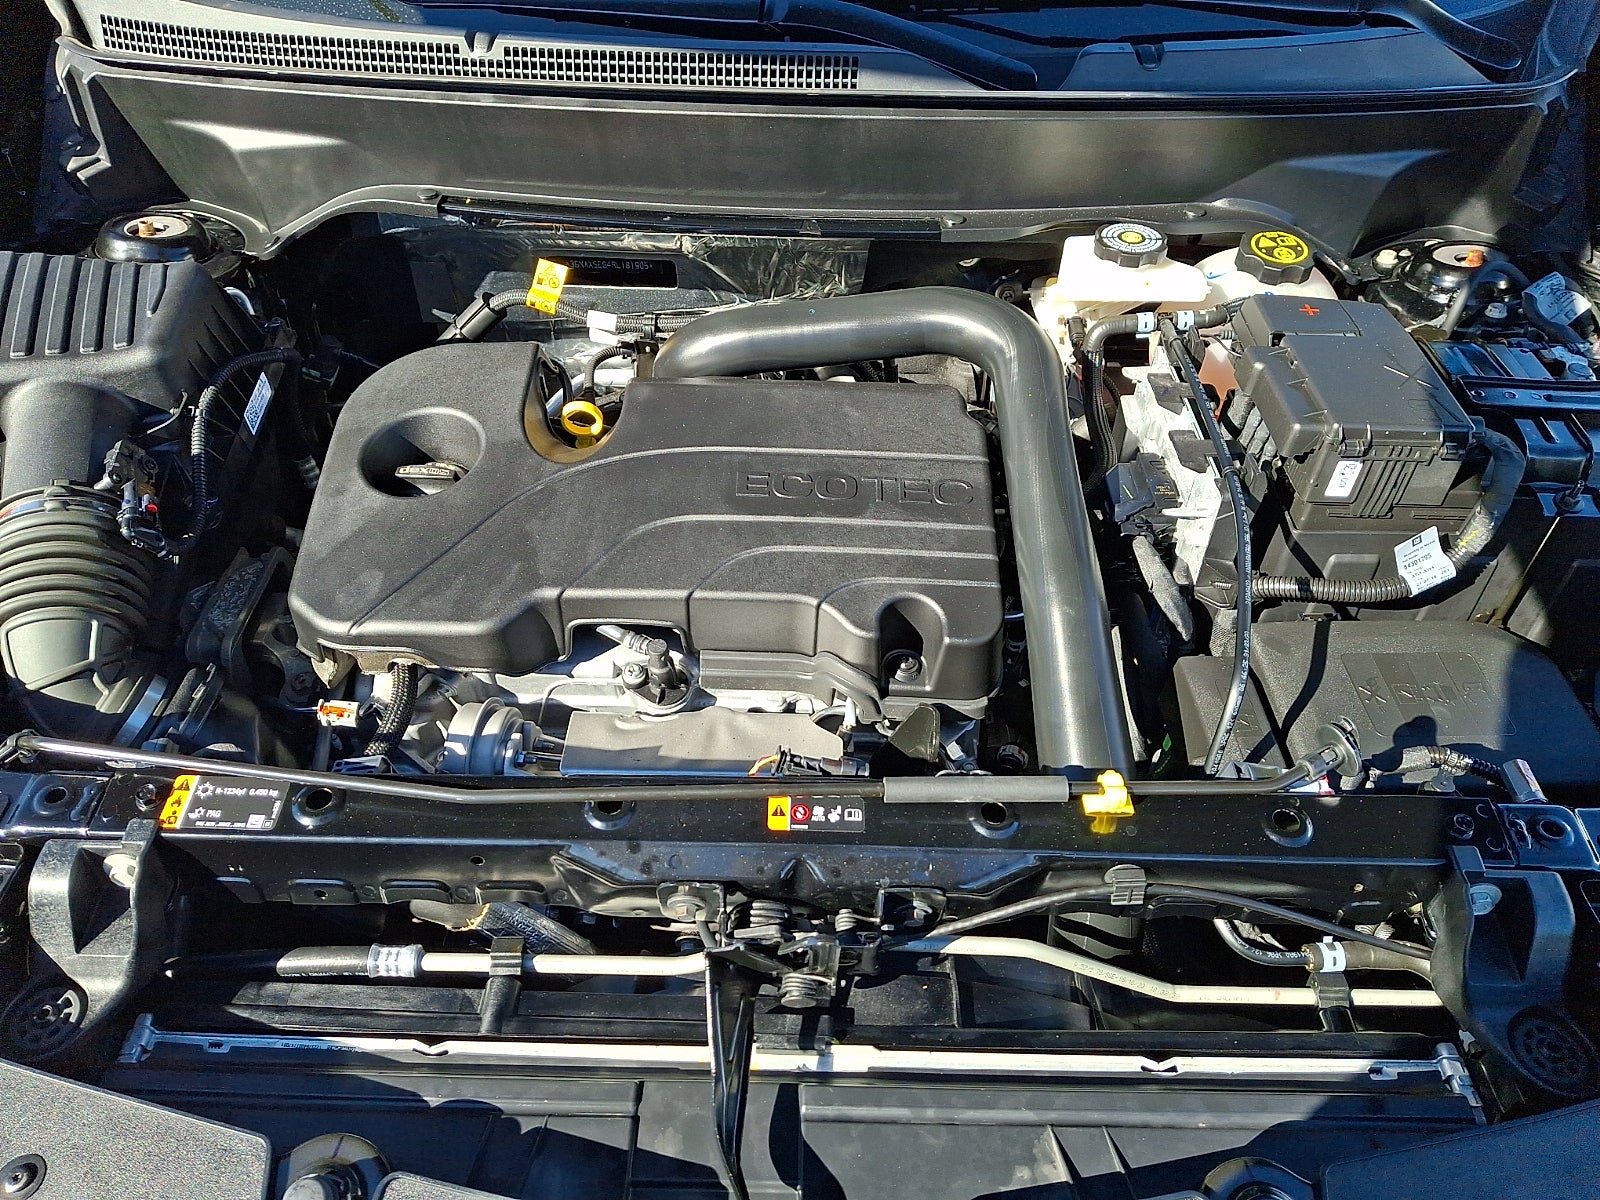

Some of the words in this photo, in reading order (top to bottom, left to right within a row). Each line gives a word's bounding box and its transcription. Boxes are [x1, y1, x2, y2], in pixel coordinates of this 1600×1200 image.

[735, 471, 974, 506] ECOTEC
[215, 787, 246, 797] R-1234yf
[206, 809, 222, 818] PAG
